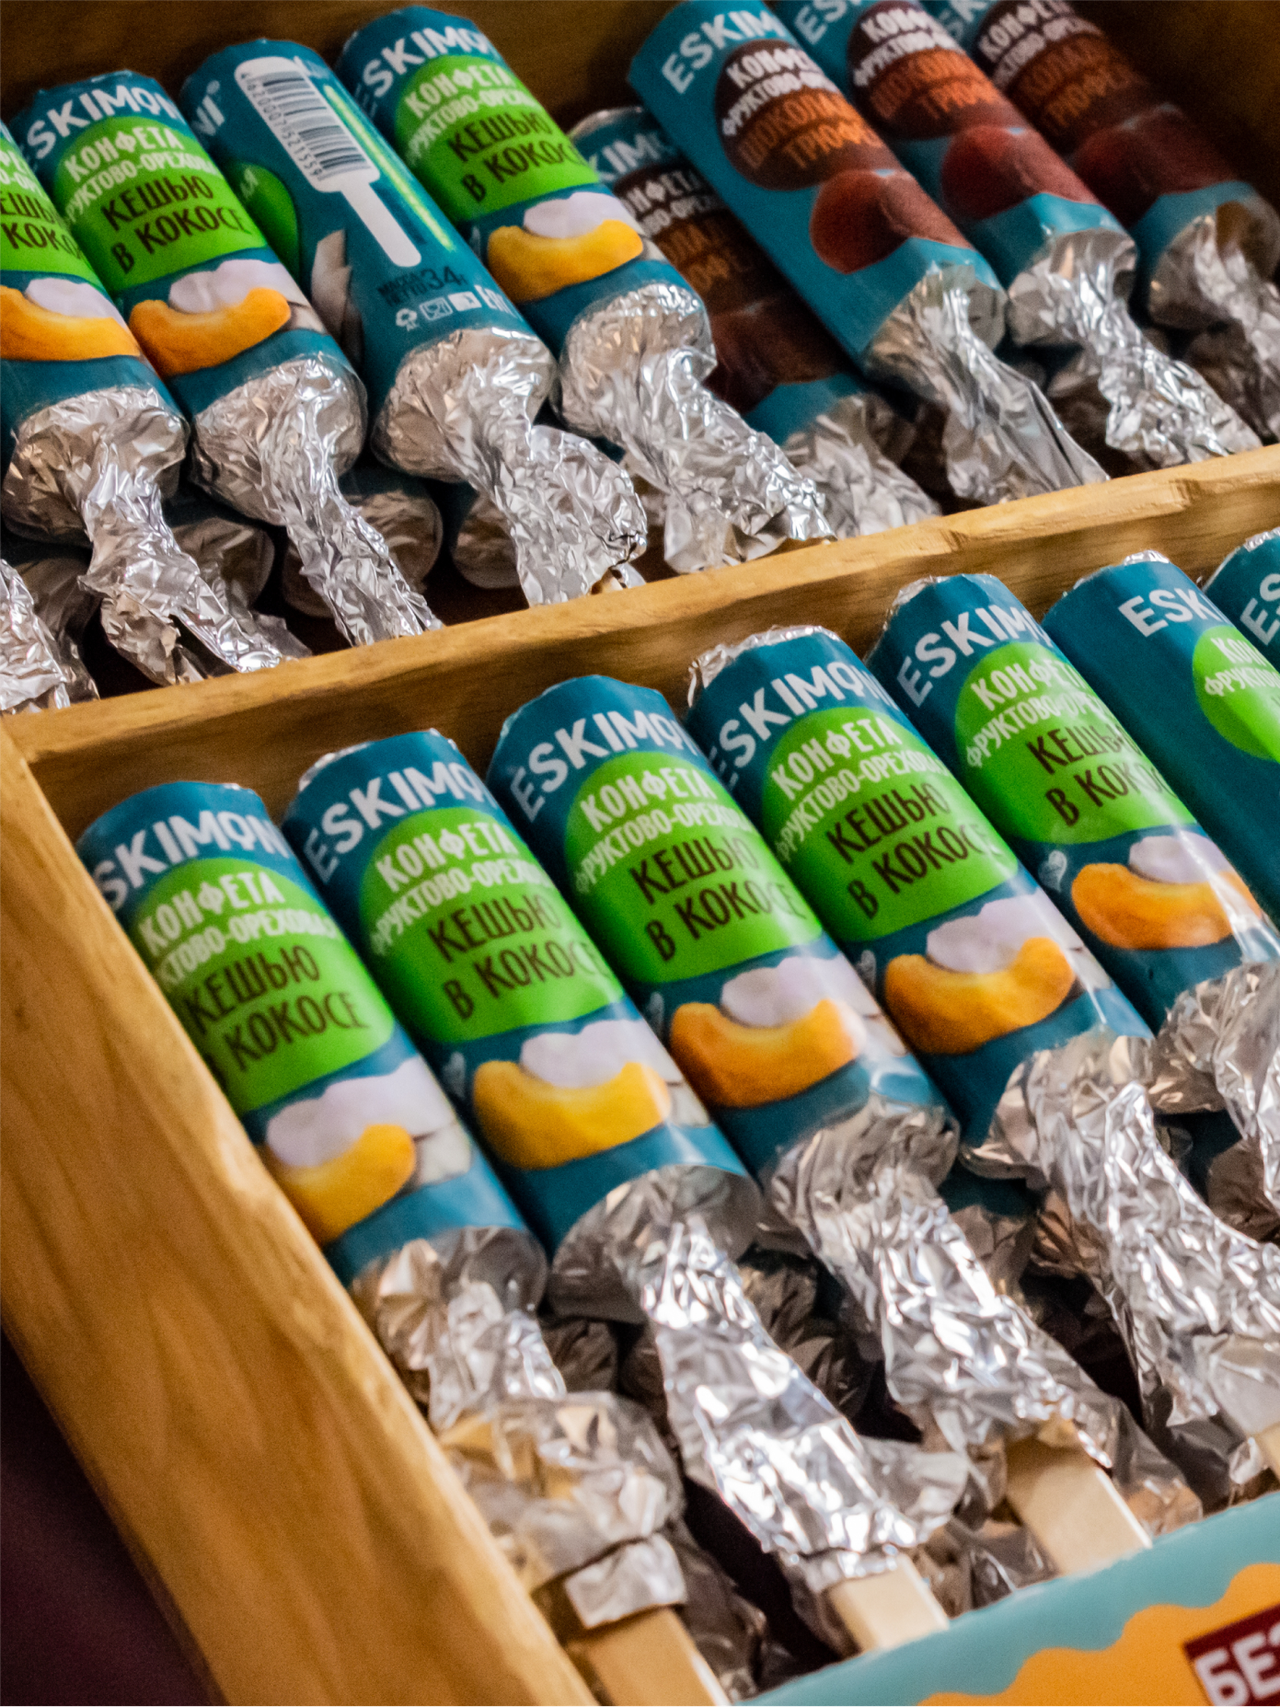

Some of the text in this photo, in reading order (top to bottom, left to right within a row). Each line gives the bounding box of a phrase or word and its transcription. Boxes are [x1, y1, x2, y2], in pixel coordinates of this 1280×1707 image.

[661, 10, 790, 94] ESKIM
[405, 64, 517, 120] КОНФЕТА
[64, 126, 186, 184] КОНФЕТА
[101, 175, 214, 232] КЕШЬЮ
[771, 716, 903, 800] КОНФЕТА
[580, 766, 718, 832] КОНФЕТА
[826, 782, 949, 866] КЕШЬЮ
[1045, 787, 1080, 827] В
[376, 822, 518, 893] КОНФЕТА
[629, 836, 760, 906] КЕШЬЮ
[138, 871, 286, 957] КОНФЕТА
[427, 893, 562, 963] КЕШЬЮ
[644, 878, 808, 963] В КОКОСЕ
[847, 879, 880, 920] В
[180, 945, 320, 1035] КЕШЬЮ
[443, 978, 475, 1021] В
[222, 991, 370, 1073] КОКОСЕ
